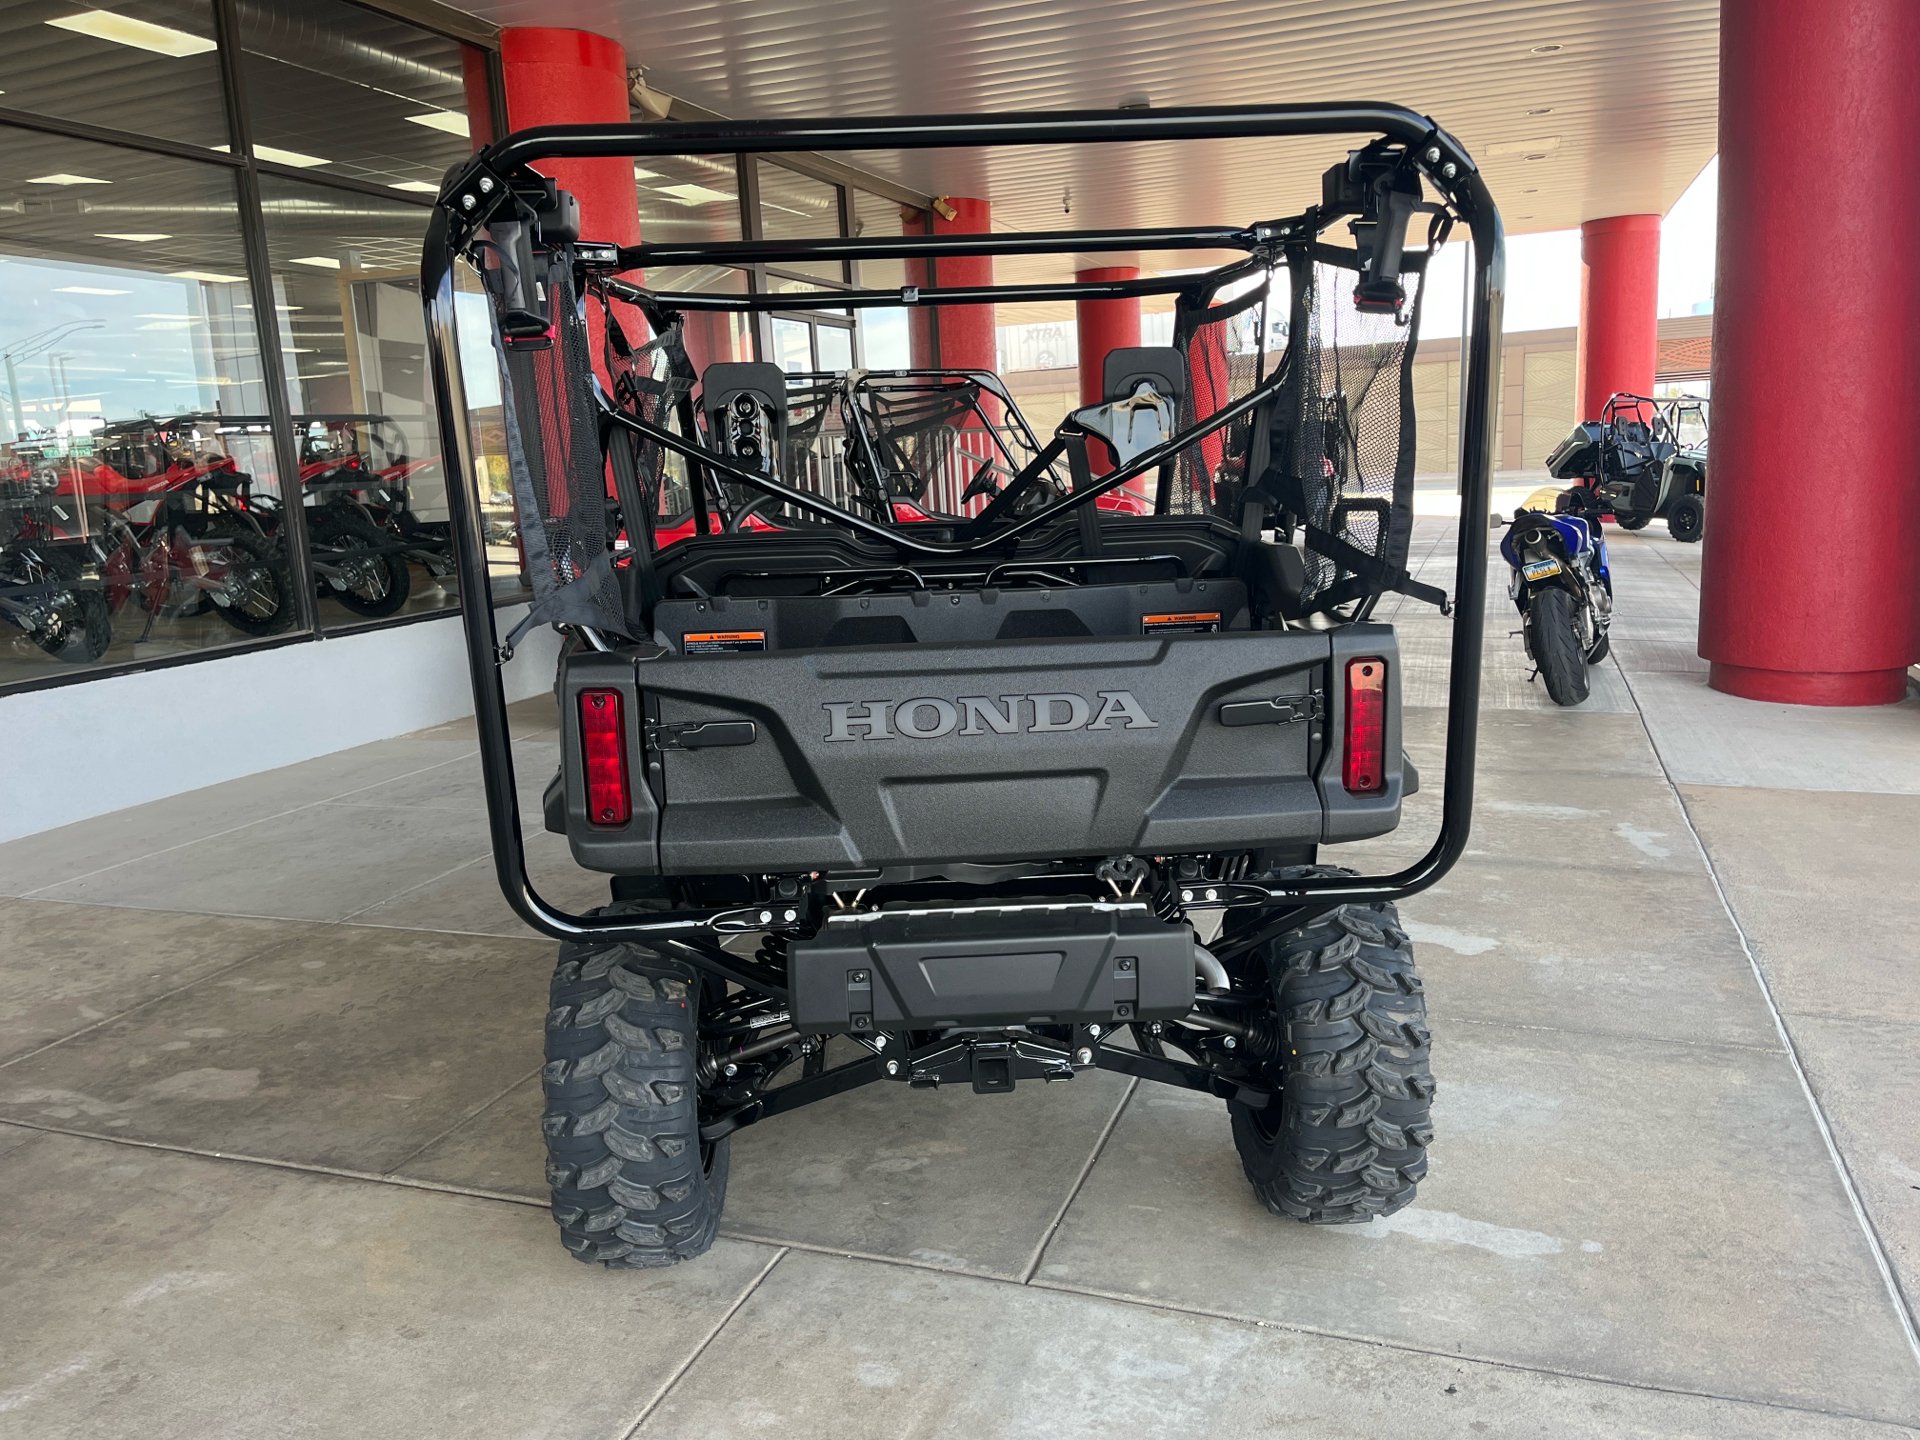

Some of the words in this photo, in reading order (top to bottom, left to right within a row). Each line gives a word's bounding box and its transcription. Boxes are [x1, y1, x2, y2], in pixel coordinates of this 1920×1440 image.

[1022, 326, 1063, 344] XTRA
[148, 480, 170, 491] HONDA
[822, 690, 1159, 743] HONDA
